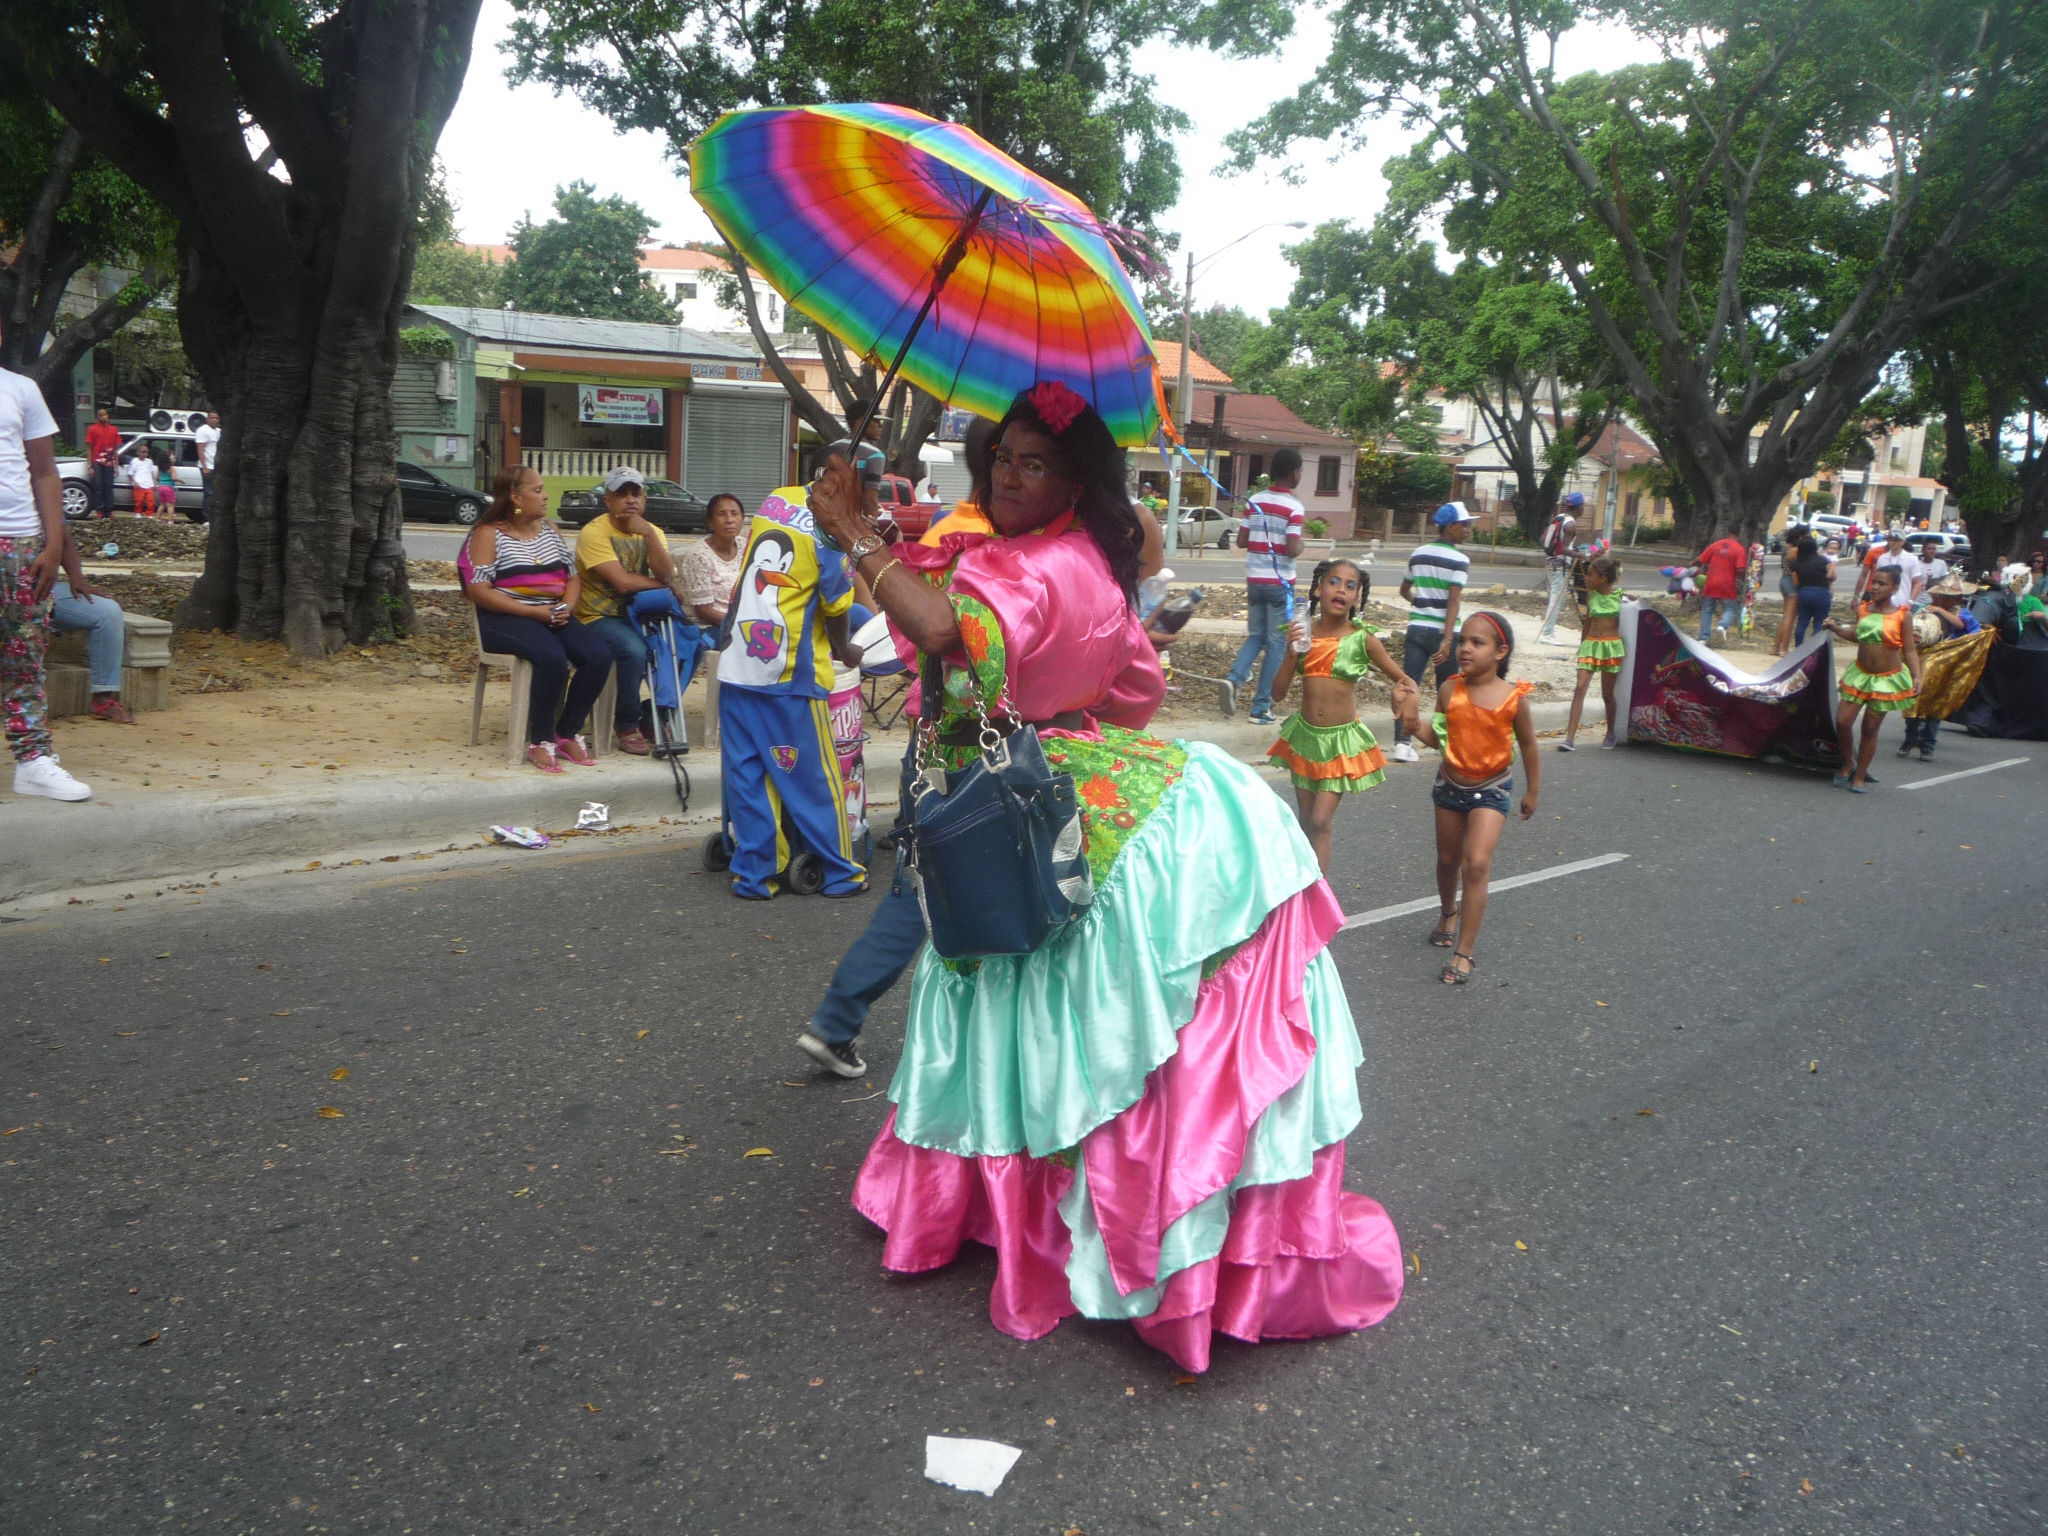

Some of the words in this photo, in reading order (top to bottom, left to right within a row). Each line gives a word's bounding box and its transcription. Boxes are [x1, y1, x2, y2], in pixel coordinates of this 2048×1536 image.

[691, 363, 726, 379] PAKA
[737, 366, 762, 380] CHE
[747, 620, 779, 659] S
